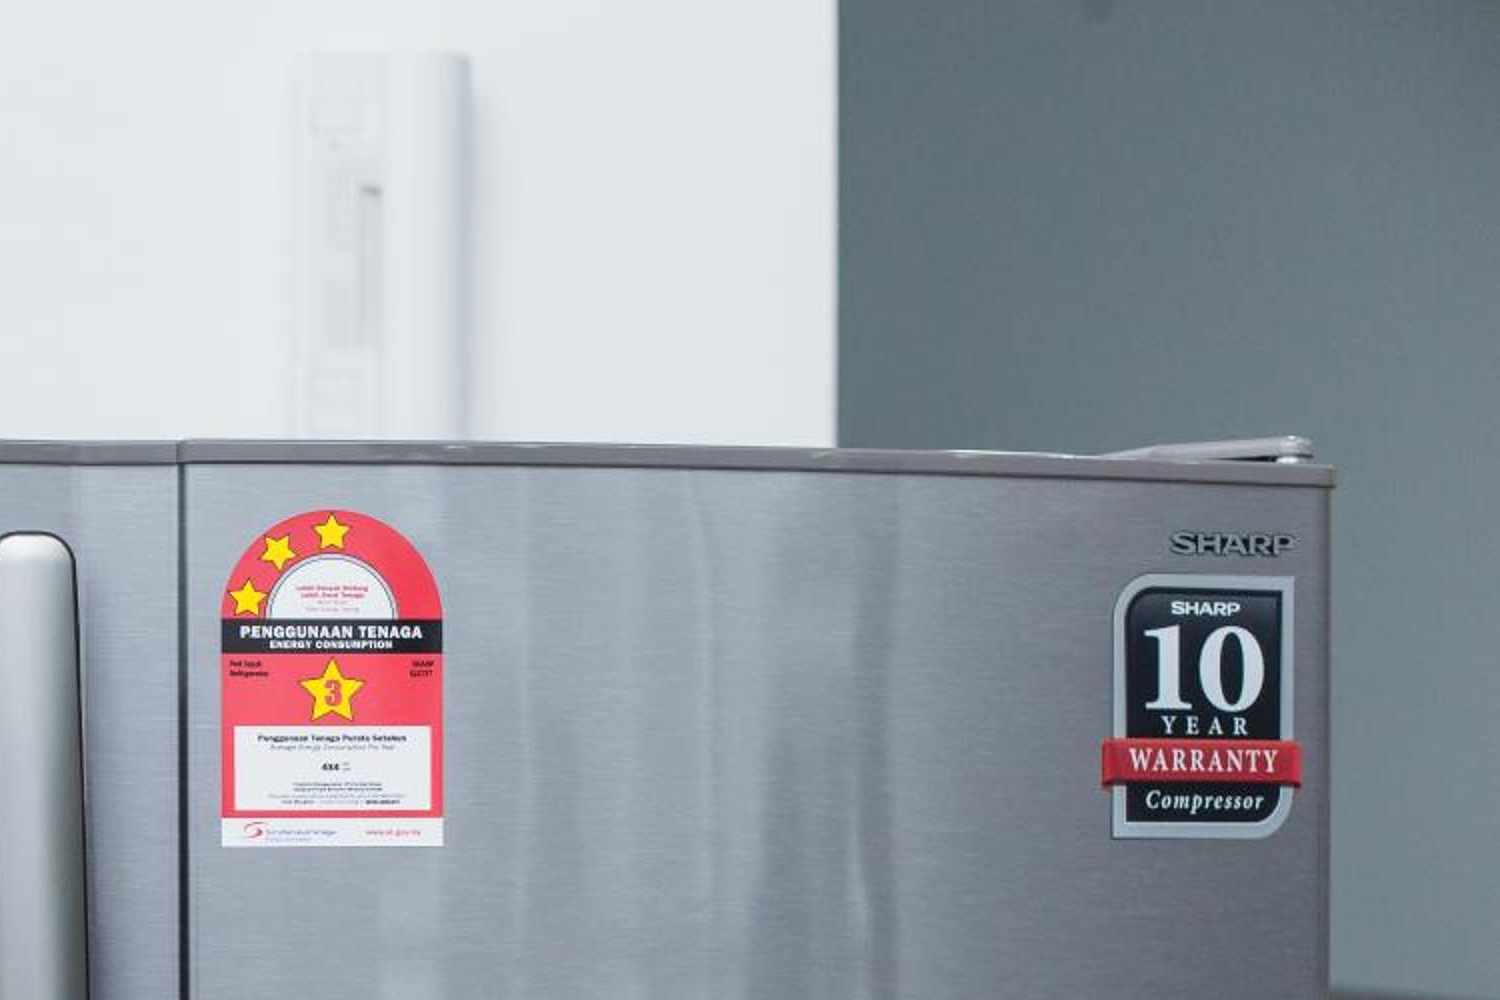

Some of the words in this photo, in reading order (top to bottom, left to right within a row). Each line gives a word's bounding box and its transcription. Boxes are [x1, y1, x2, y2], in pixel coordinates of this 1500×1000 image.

[1171, 530, 1296, 556] SHARP
[1171, 601, 1241, 616] SHARP
[240, 625, 353, 639] PENGGUNAAN
[358, 625, 423, 639] TENAGA
[269, 639, 311, 649] ENERGY
[315, 639, 393, 649] CONSUMPTION
[1144, 624, 1265, 713] 10
[323, 679, 343, 707] 3
[1161, 715, 1249, 736] YEAR
[1129, 748, 1280, 773] WARRANTY
[1145, 789, 1265, 814] Compressor
